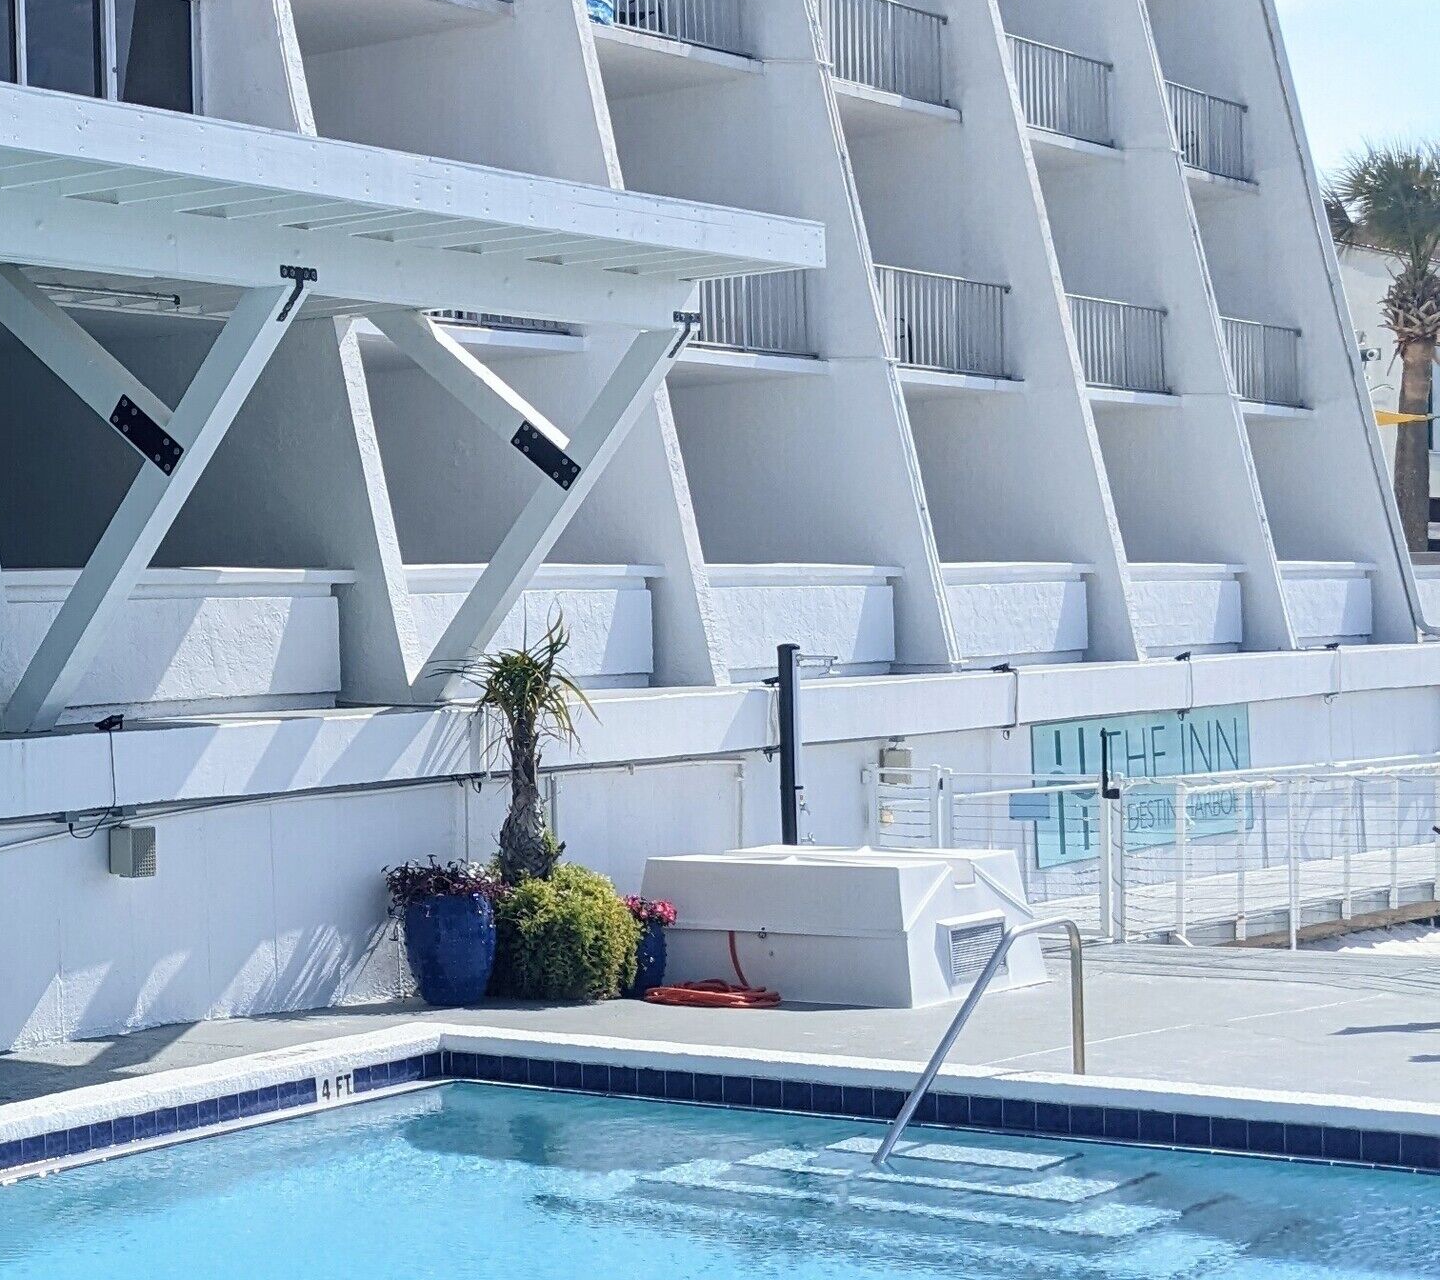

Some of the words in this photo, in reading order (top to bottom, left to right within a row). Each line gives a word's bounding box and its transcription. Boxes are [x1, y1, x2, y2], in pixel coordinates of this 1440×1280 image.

[1180, 718, 1239, 774] INN
[1127, 798, 1176, 831] DESTIN
[322, 1079, 330, 1100] 4
